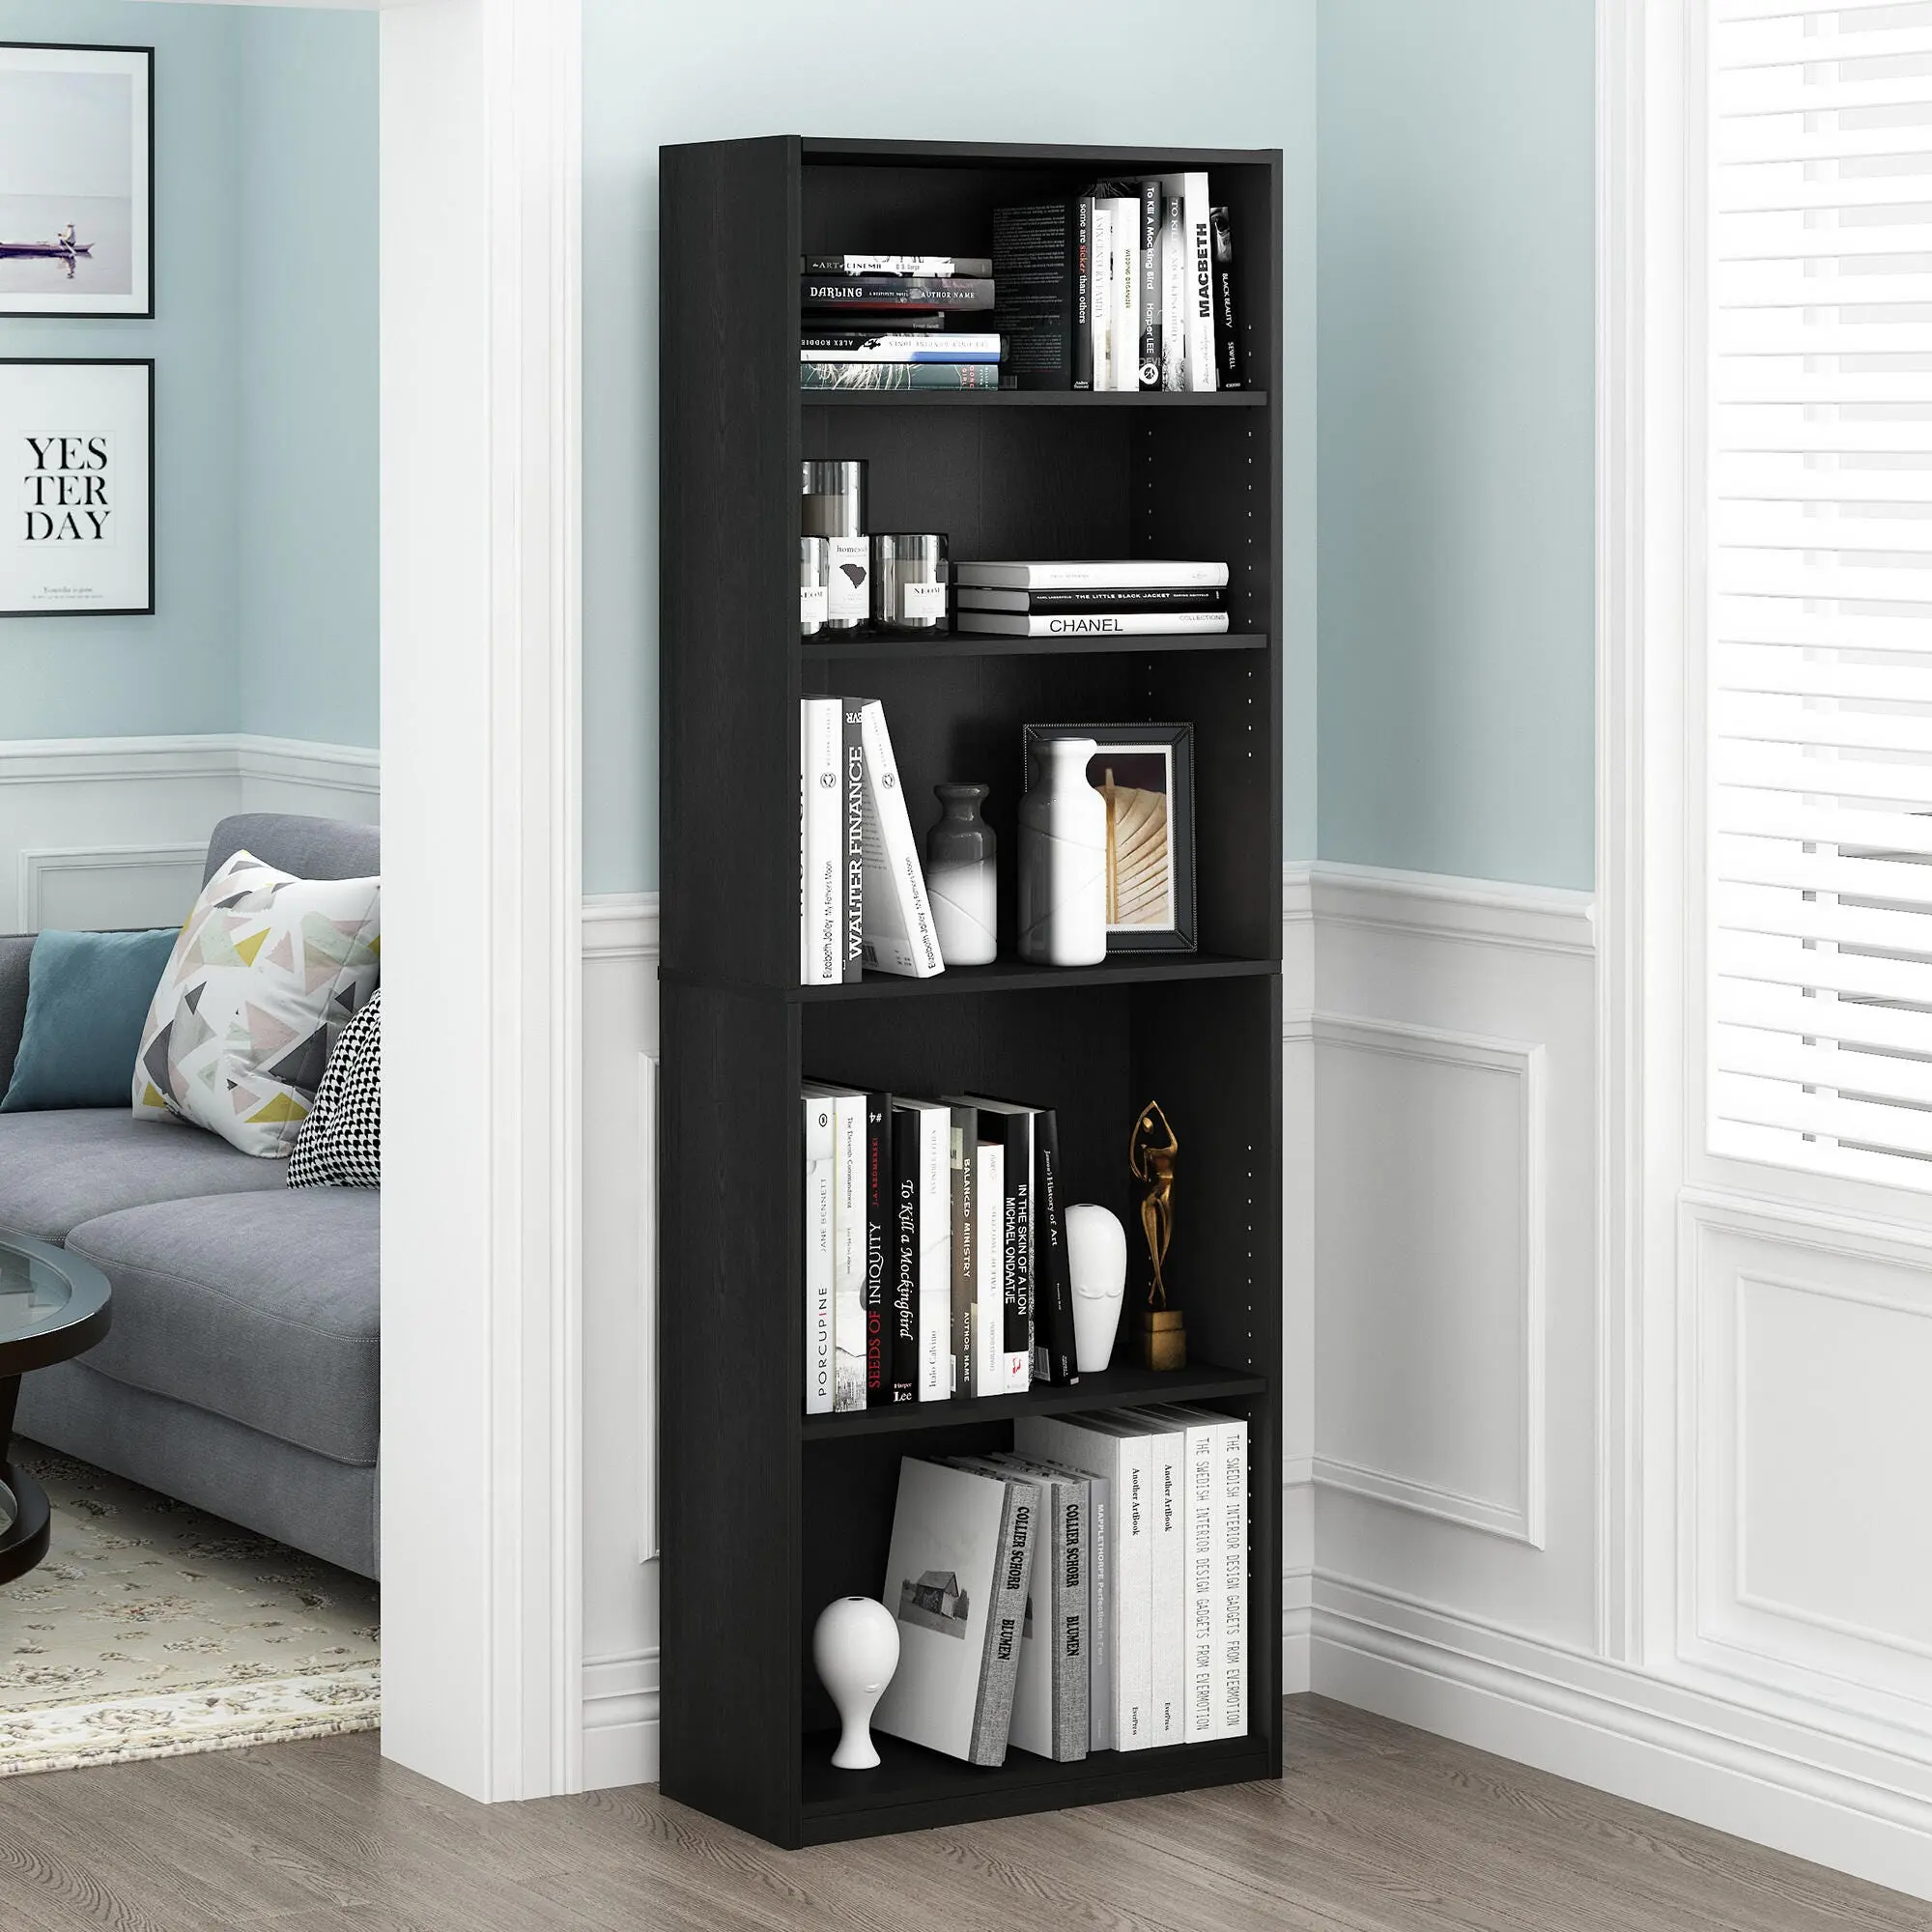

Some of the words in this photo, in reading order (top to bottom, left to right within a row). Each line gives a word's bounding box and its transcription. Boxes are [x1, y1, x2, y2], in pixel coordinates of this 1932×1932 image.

[1146, 187, 1154, 199] To
[1171, 199, 1179, 217] TO
[1146, 216, 1154, 226] A
[1196, 223, 1210, 318] MACBETH
[810, 287, 863, 298] DARLING
[1145, 302, 1154, 337] Harper
[1146, 337, 1154, 354] LEE
[25, 437, 108, 470] YES
[24, 475, 109, 506] TER
[24, 510, 112, 541] DAY
[1049, 618, 1123, 633] CHANEL
[849, 746, 863, 856] FINANCE
[823, 942, 833, 979] Elizabeth
[869, 1113, 882, 1122] #4
[901, 1179, 914, 1198] To
[1018, 1184, 1027, 1197] IN
[898, 1202, 915, 1235] Kill
[1006, 1197, 1015, 1245] MICHAEL
[1018, 1199, 1027, 1223] THE
[1050, 1214, 1057, 1225] of
[1018, 1226, 1027, 1254] SKIN
[869, 1221, 884, 1304] INIQUITY
[1005, 1246, 1015, 1304] ONDAATJE
[1017, 1256, 1027, 1274] OF
[894, 1247, 914, 1341] Mockingbird
[1017, 1276, 1027, 1285] A
[1017, 1288, 1027, 1316] LION
[868, 1311, 881, 1334] OF
[818, 1288, 828, 1396] PORCUPINE
[868, 1339, 881, 1388] SEEDS
[893, 1391, 912, 1402] Lee
[1196, 1437, 1209, 1455] THE
[1226, 1435, 1239, 1452] THE
[1164, 1463, 1173, 1497] Another
[1196, 1461, 1209, 1501] SWEDISH
[1226, 1457, 1239, 1498] SWEDISH
[1011, 1506, 1030, 1548] COLLIER
[1065, 1503, 1079, 1546] COLLIER
[1164, 1498, 1173, 1532] ArtBook
[1196, 1507, 1209, 1553] INTERIOR
[1226, 1504, 1239, 1549] INTERIOR
[1007, 1548, 1023, 1590] SCHORR
[1065, 1547, 1079, 1588] SCHORR
[1196, 1558, 1209, 1593] DESIGN
[1226, 1554, 1239, 1589] DESIGN
[1196, 1599, 1209, 1639] GADGETS
[1226, 1595, 1239, 1635] GADGETS
[997, 1618, 1015, 1661] BLUMEN
[1065, 1615, 1079, 1657] BLUMEN
[1226, 1640, 1239, 1664] FROM
[1196, 1644, 1209, 1668] FROM
[1196, 1673, 1209, 1731] EVERMOTION
[1226, 1668, 1239, 1726] EVERMOTION
